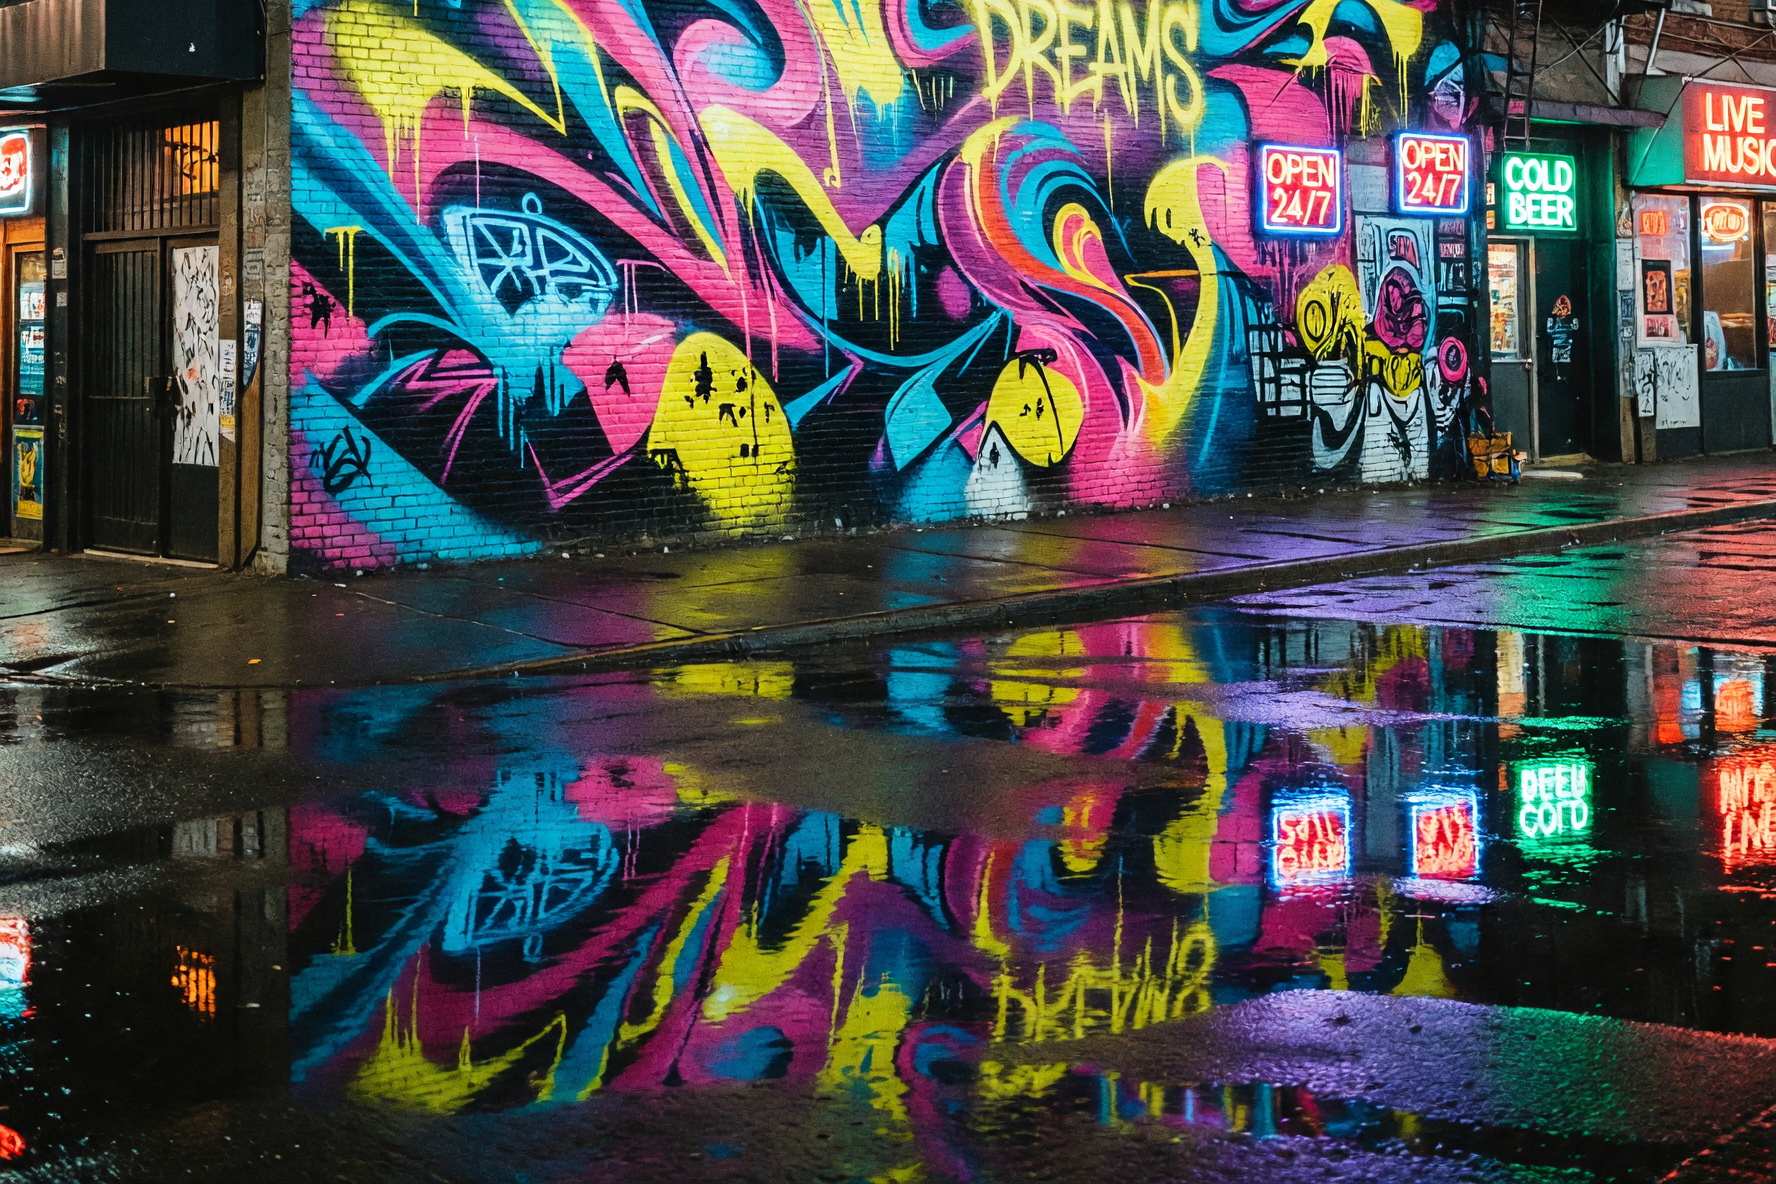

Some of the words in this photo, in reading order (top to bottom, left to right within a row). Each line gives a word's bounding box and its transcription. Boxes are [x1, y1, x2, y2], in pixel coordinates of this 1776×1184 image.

[1705, 92, 1765, 134] LIVE
[1266, 152, 1335, 188] OPEN
[1402, 139, 1464, 172] OPEN
[1405, 171, 1462, 207] 24/7
[1505, 157, 1573, 192] COLD
[1270, 187, 1332, 226] 24/7
[1508, 191, 1574, 227] BEER
